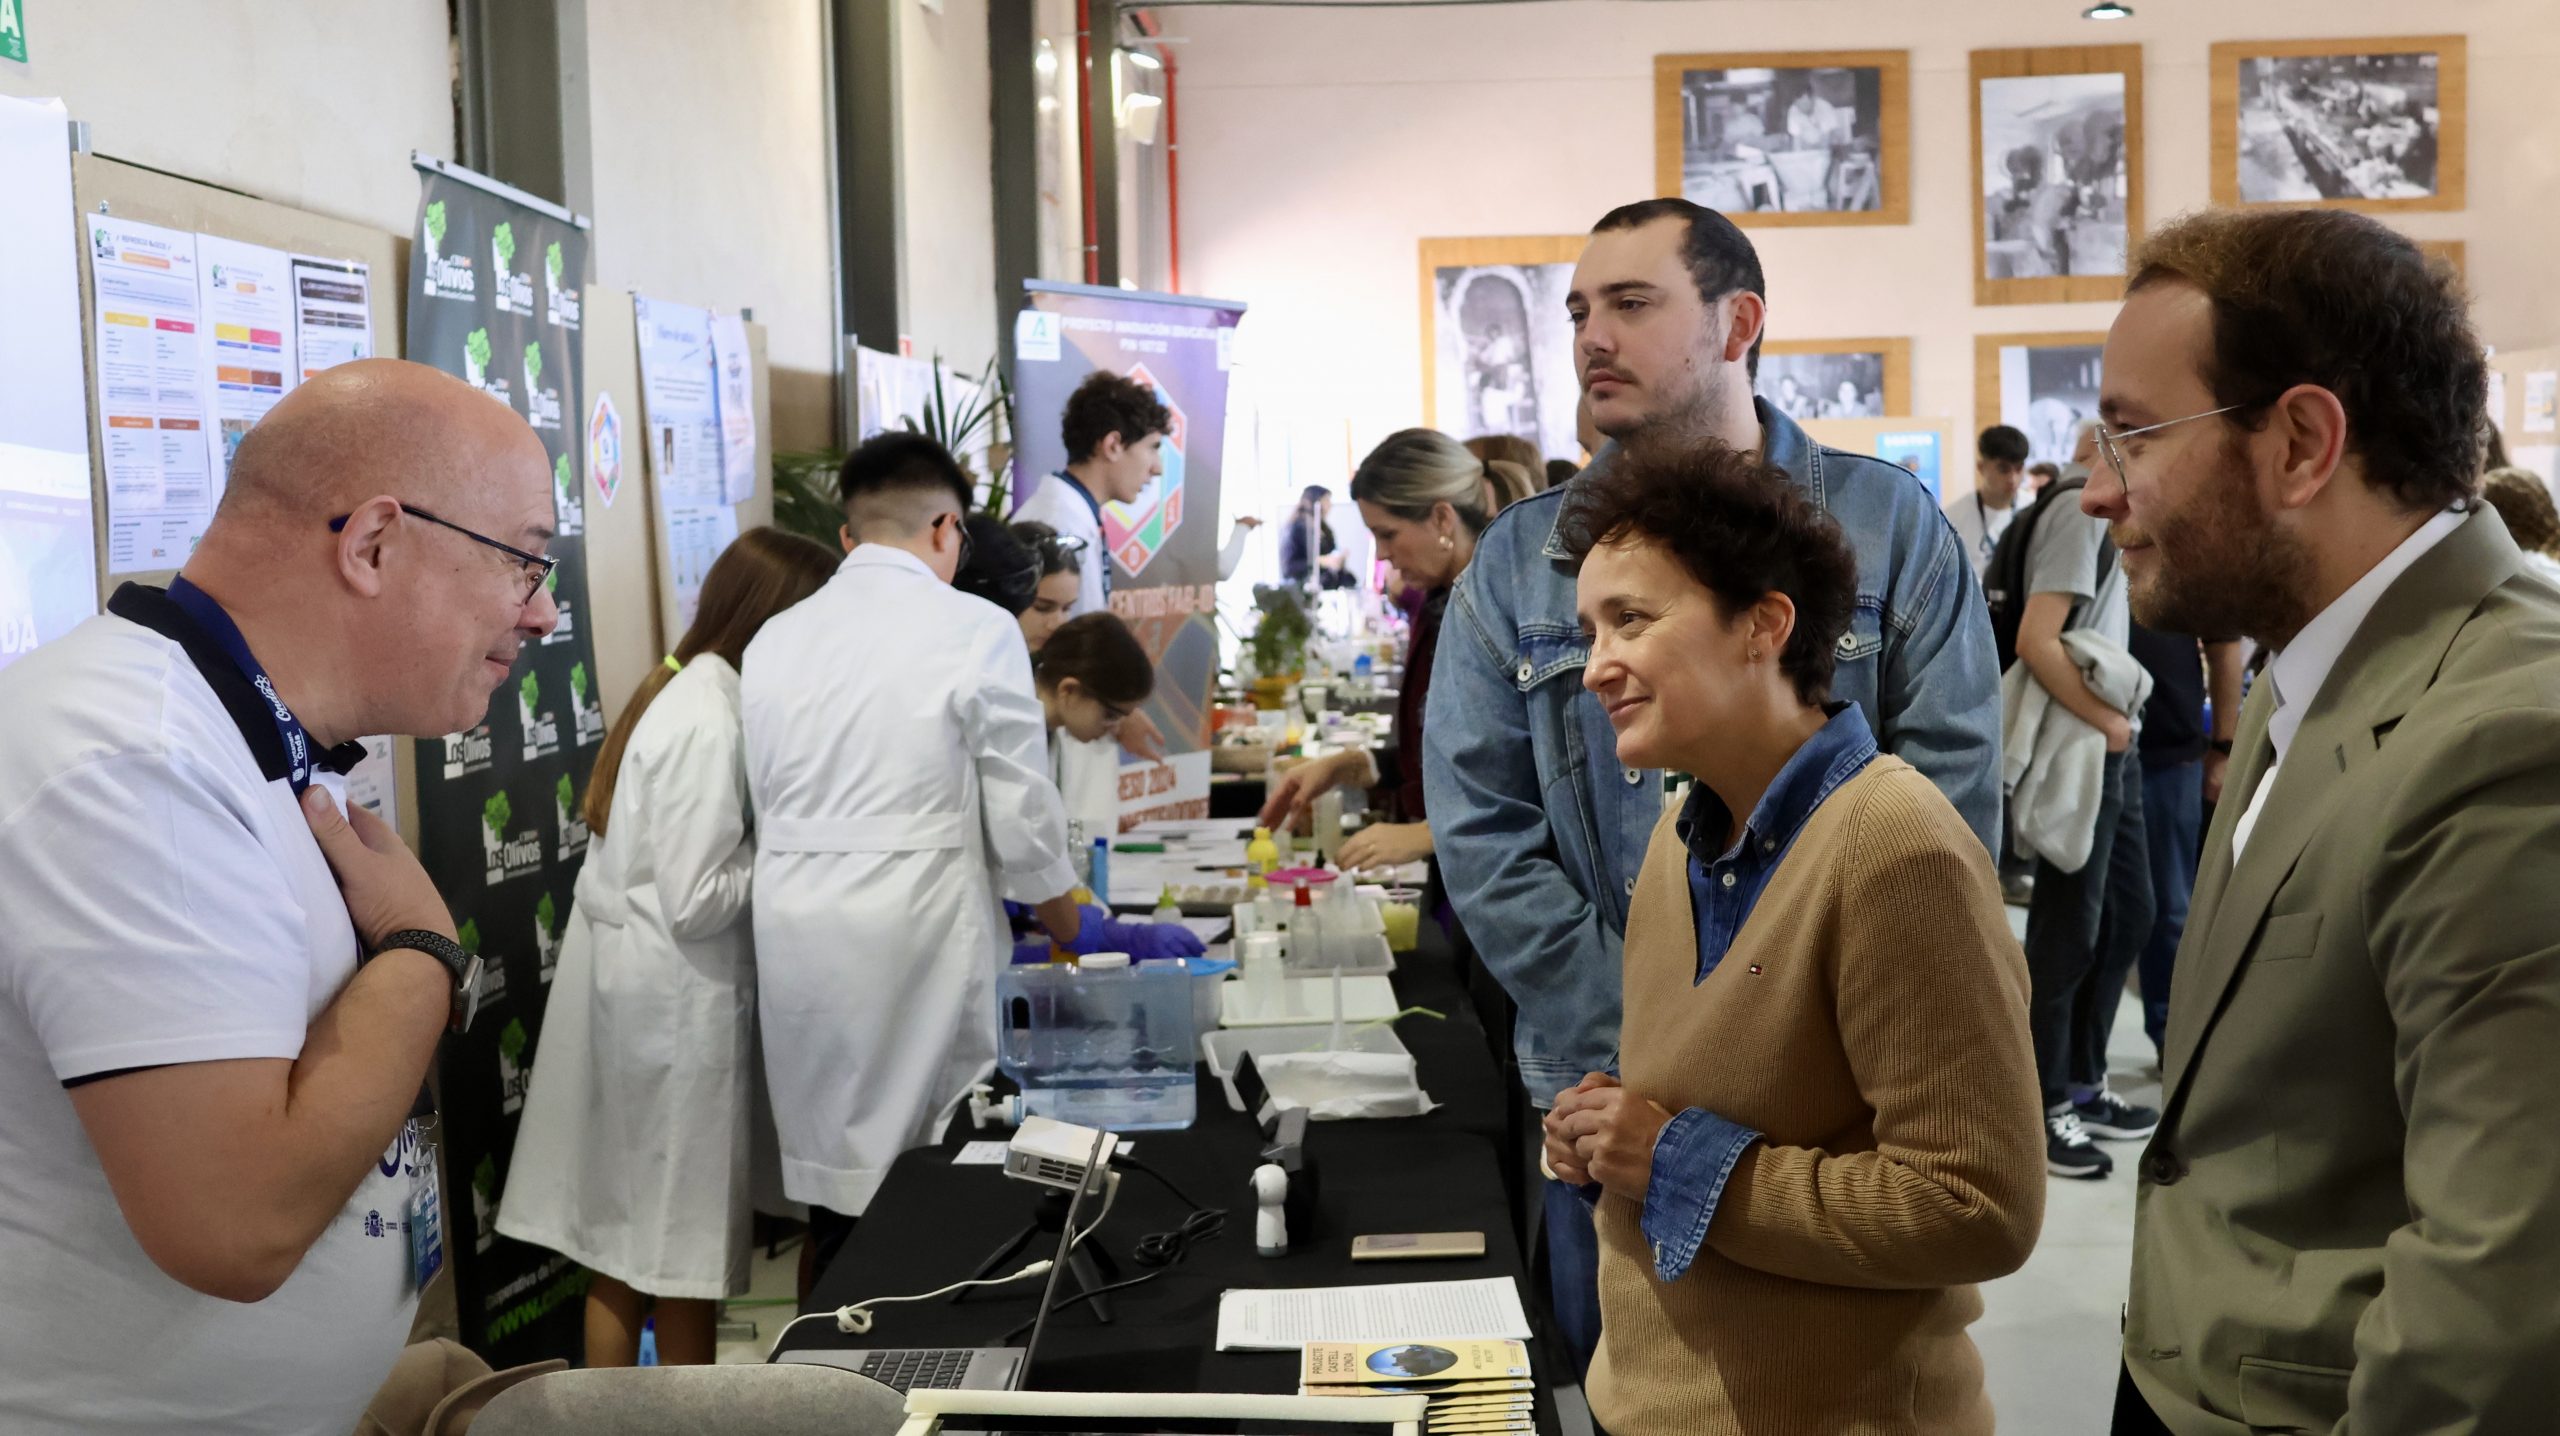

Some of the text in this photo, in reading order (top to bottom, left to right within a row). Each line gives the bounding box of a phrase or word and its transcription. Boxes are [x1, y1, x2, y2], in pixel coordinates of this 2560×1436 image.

[294, 734, 304, 760] Onda
[464, 736, 492, 763] Olivos
[503, 841, 542, 869] Olivos
[1312, 1347, 1324, 1375] PROJECTE
[1327, 1350, 1339, 1373] CASTELL
[1343, 1352, 1355, 1373] D'ONDA
